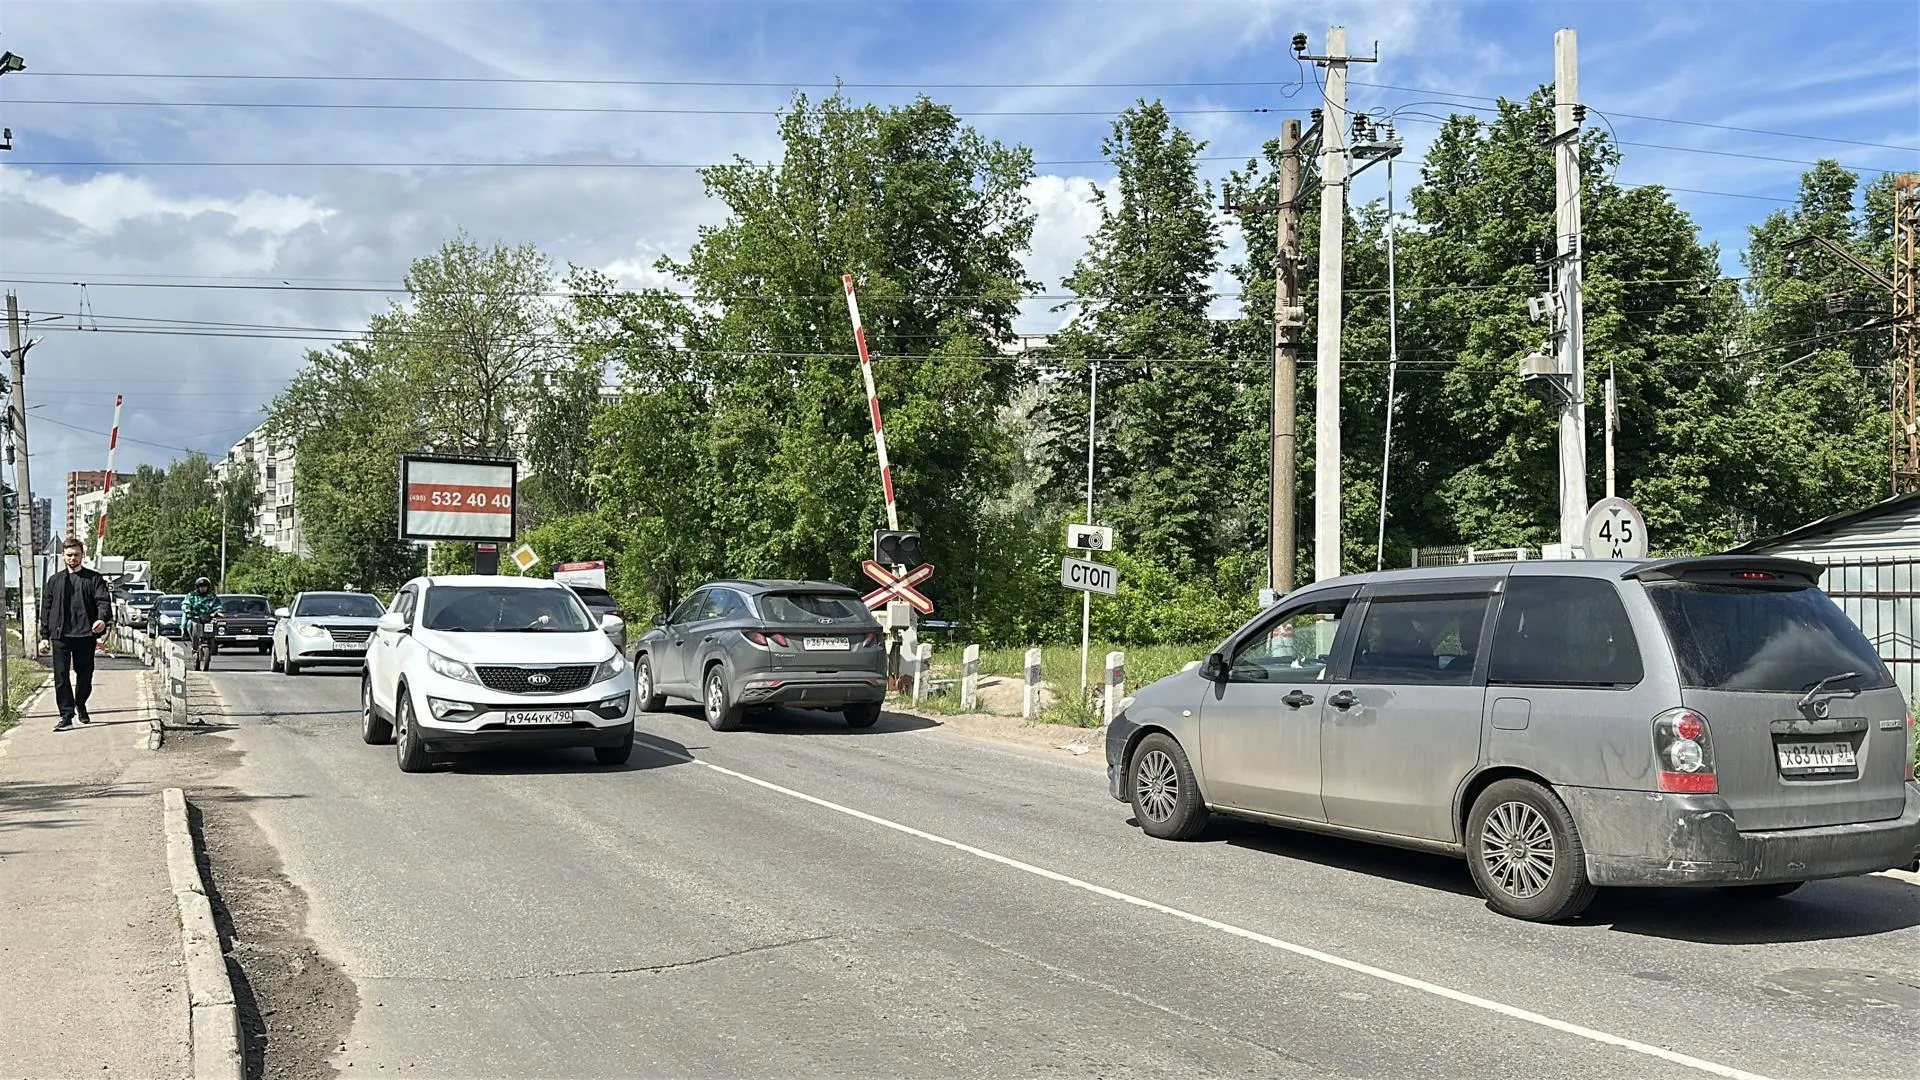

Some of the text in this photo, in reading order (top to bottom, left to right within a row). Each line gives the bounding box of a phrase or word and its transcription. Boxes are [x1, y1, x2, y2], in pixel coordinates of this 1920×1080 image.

[410, 491, 511, 508] (495) 532 40 40
[1599, 520, 1632, 547] 4,5
[1071, 564, 1111, 588] СТОП
[509, 711, 570, 723] А944УК 790
[1783, 744, 1848, 766] Х831КУ 37
